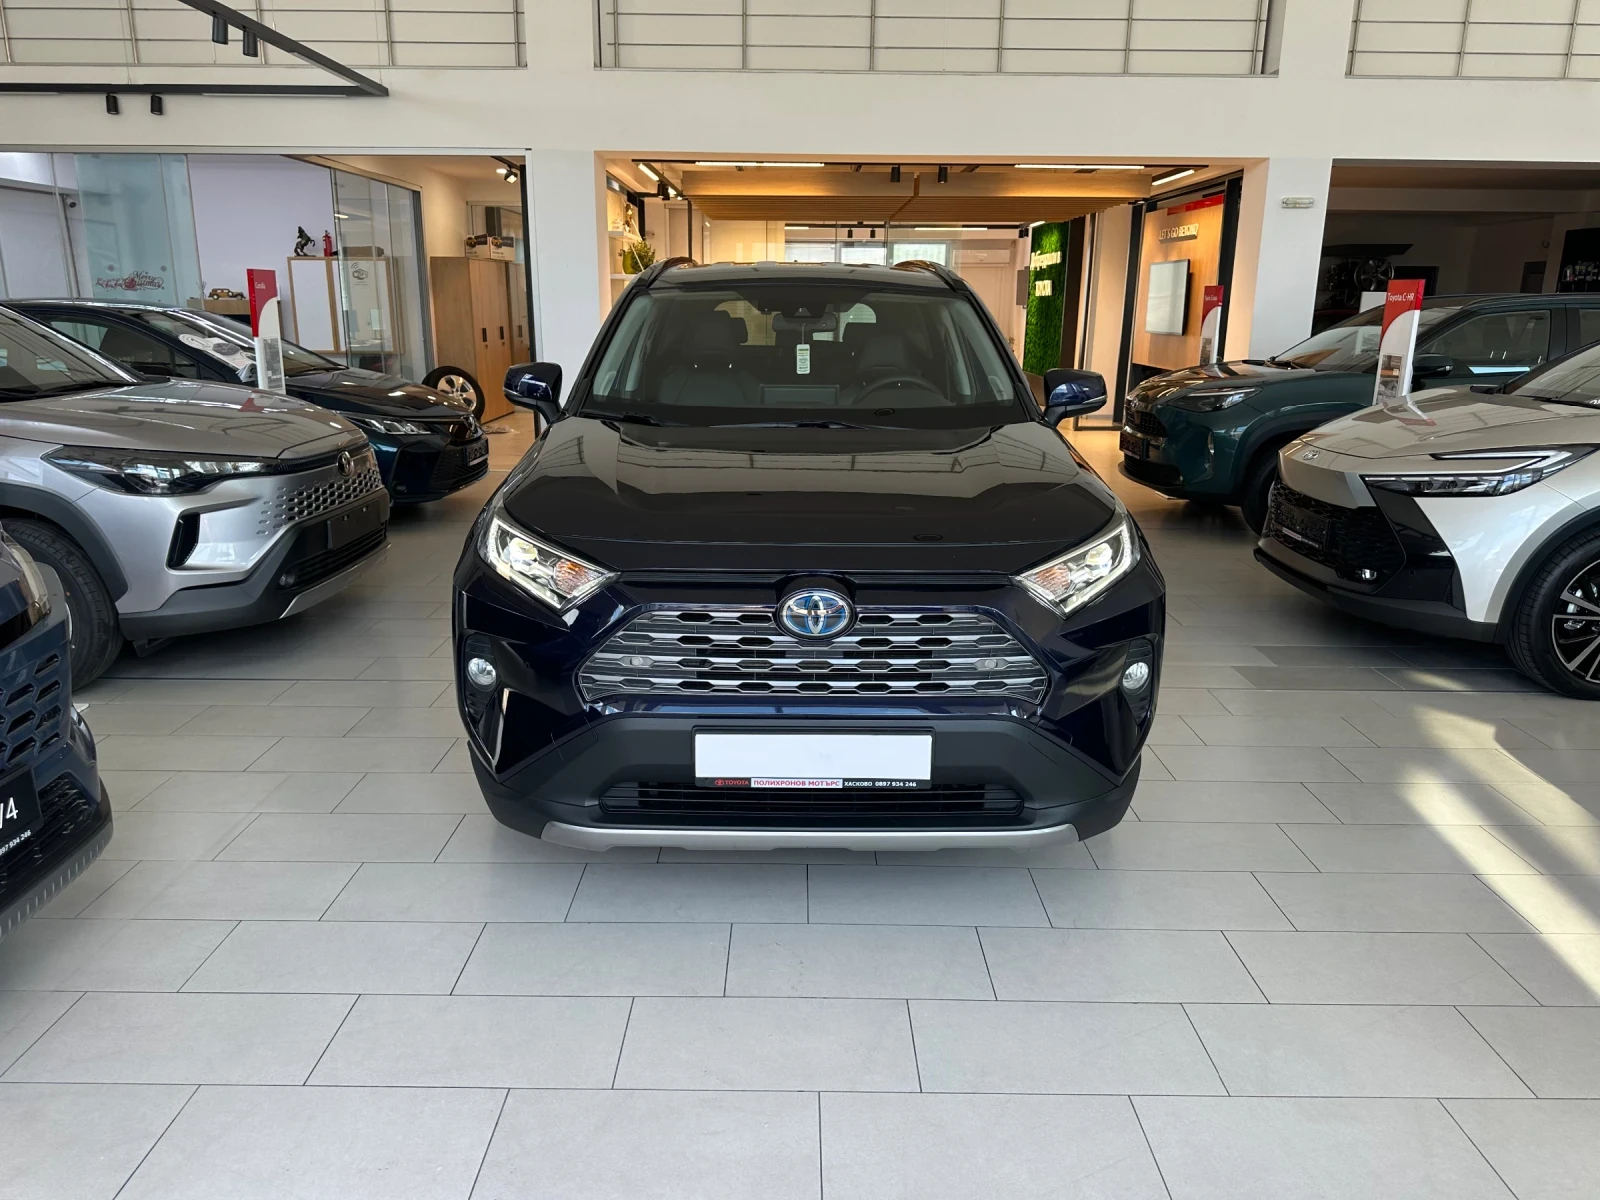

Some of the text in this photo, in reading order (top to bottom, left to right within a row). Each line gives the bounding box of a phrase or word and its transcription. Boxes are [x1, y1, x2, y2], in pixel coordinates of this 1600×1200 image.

[1388, 292, 1415, 303] Toyota C-HR
[753, 779, 806, 787] ПОЛИХРОНОВ
